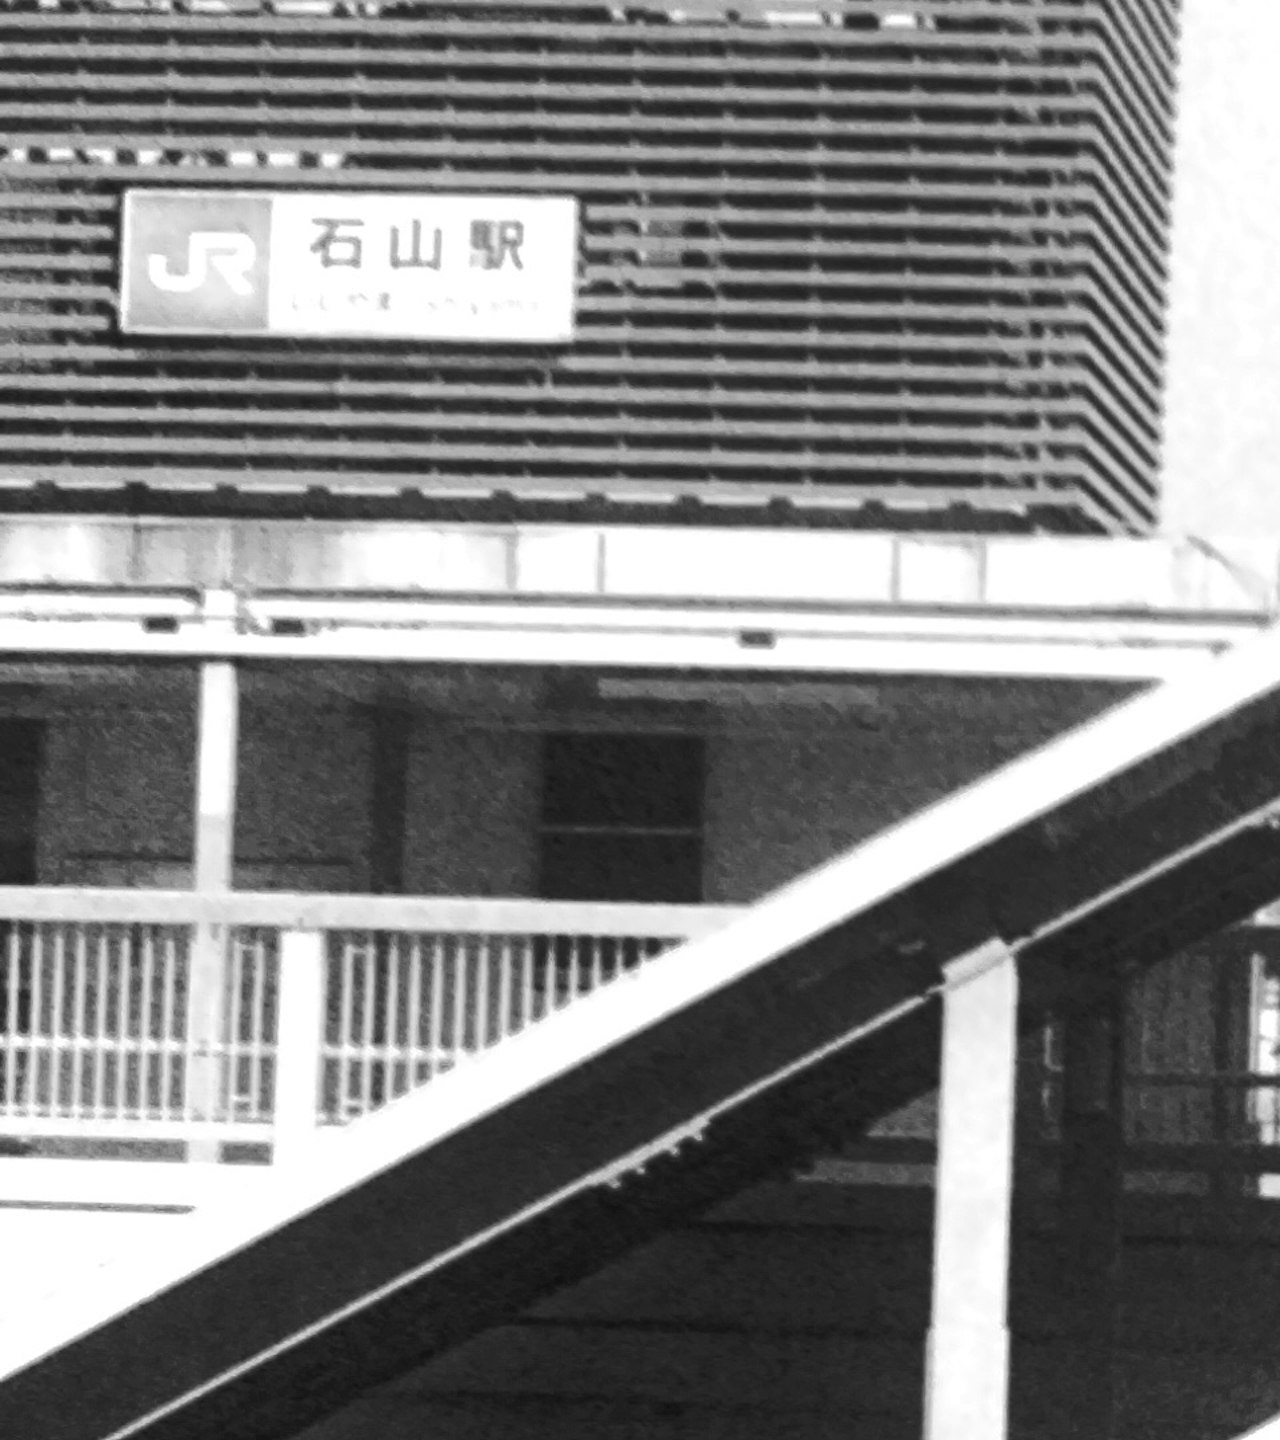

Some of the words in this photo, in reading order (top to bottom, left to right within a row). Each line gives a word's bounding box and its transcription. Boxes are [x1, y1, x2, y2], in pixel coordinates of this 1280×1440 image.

[147, 231, 256, 295] JR
[309, 217, 525, 271] 石山駅
